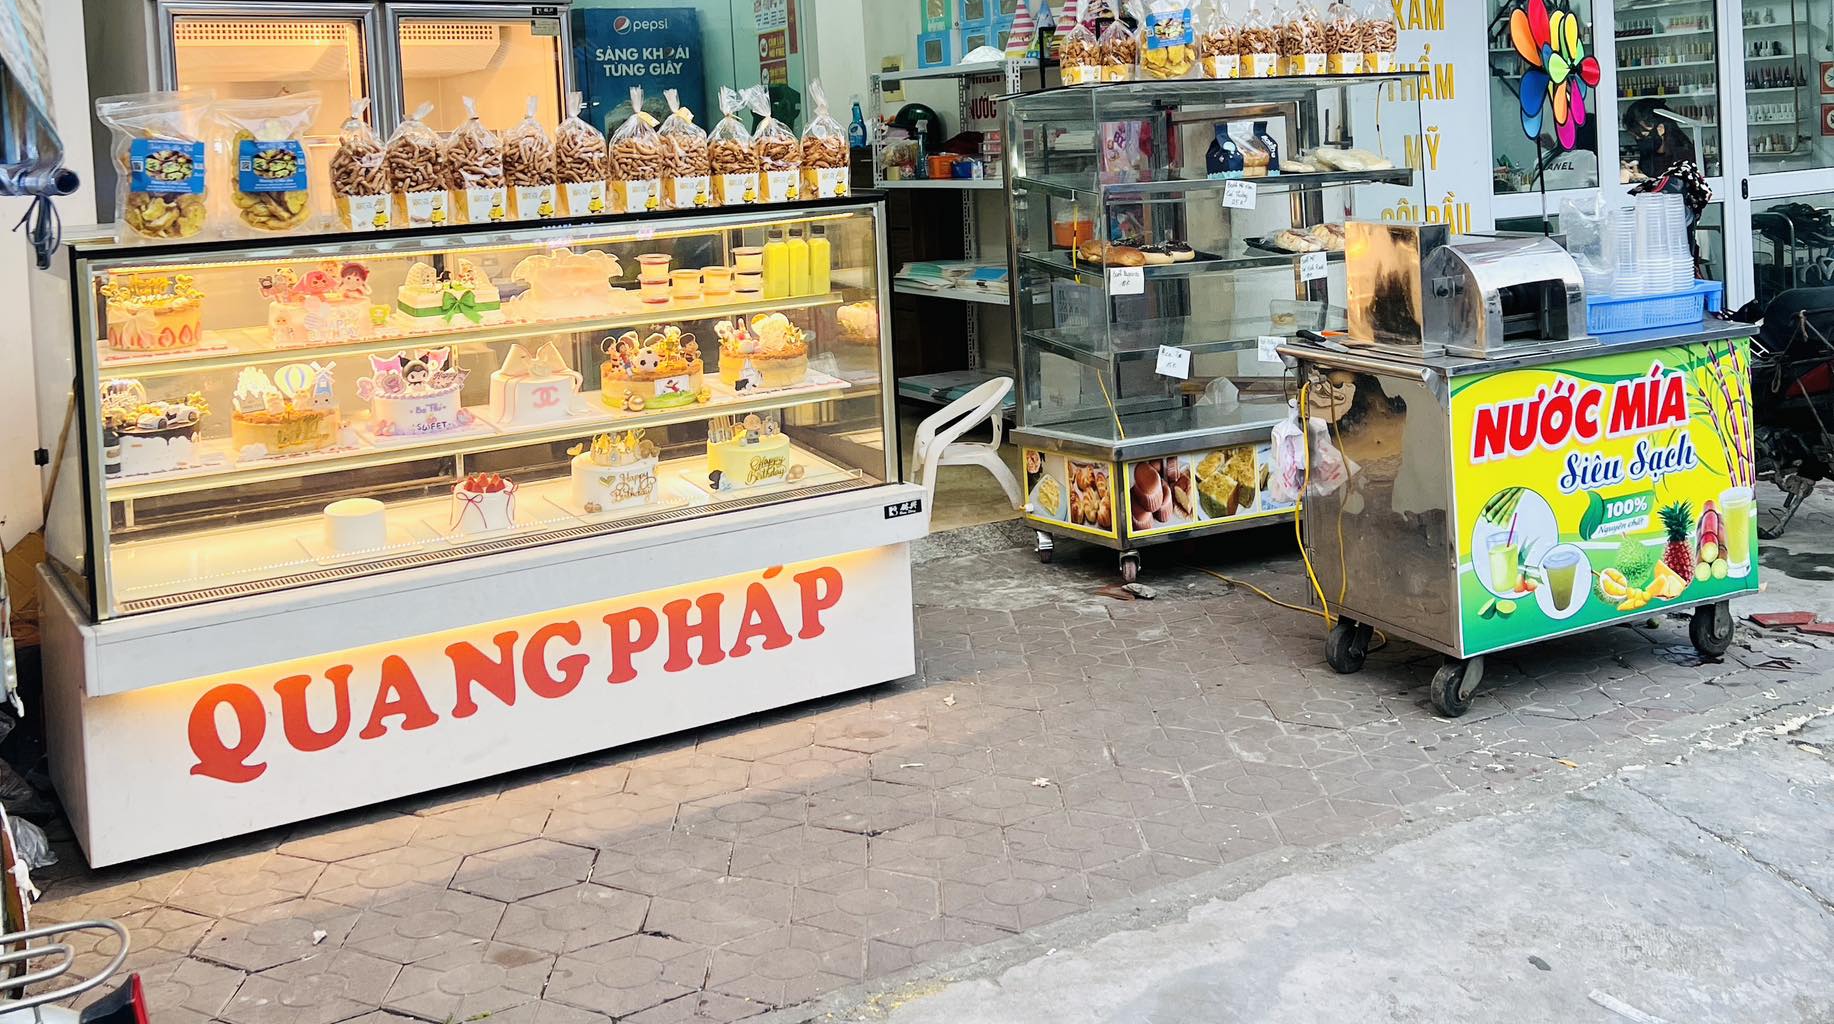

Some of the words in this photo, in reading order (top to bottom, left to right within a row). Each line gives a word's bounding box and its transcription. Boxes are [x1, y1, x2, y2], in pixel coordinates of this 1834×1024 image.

[633, 18, 668, 32] pepsi
[649, 60, 683, 75] GIÂY
[1404, 126, 1441, 171] MỸ
[1474, 378, 1602, 459] NƯỚC
[1609, 364, 1687, 434] MÍA
[1561, 453, 1621, 490] Siêu
[1630, 433, 1696, 479] Sạch
[1606, 496, 1648, 519] 100%
[188, 621, 590, 784] QUANG
[603, 565, 843, 685] PHÁP
